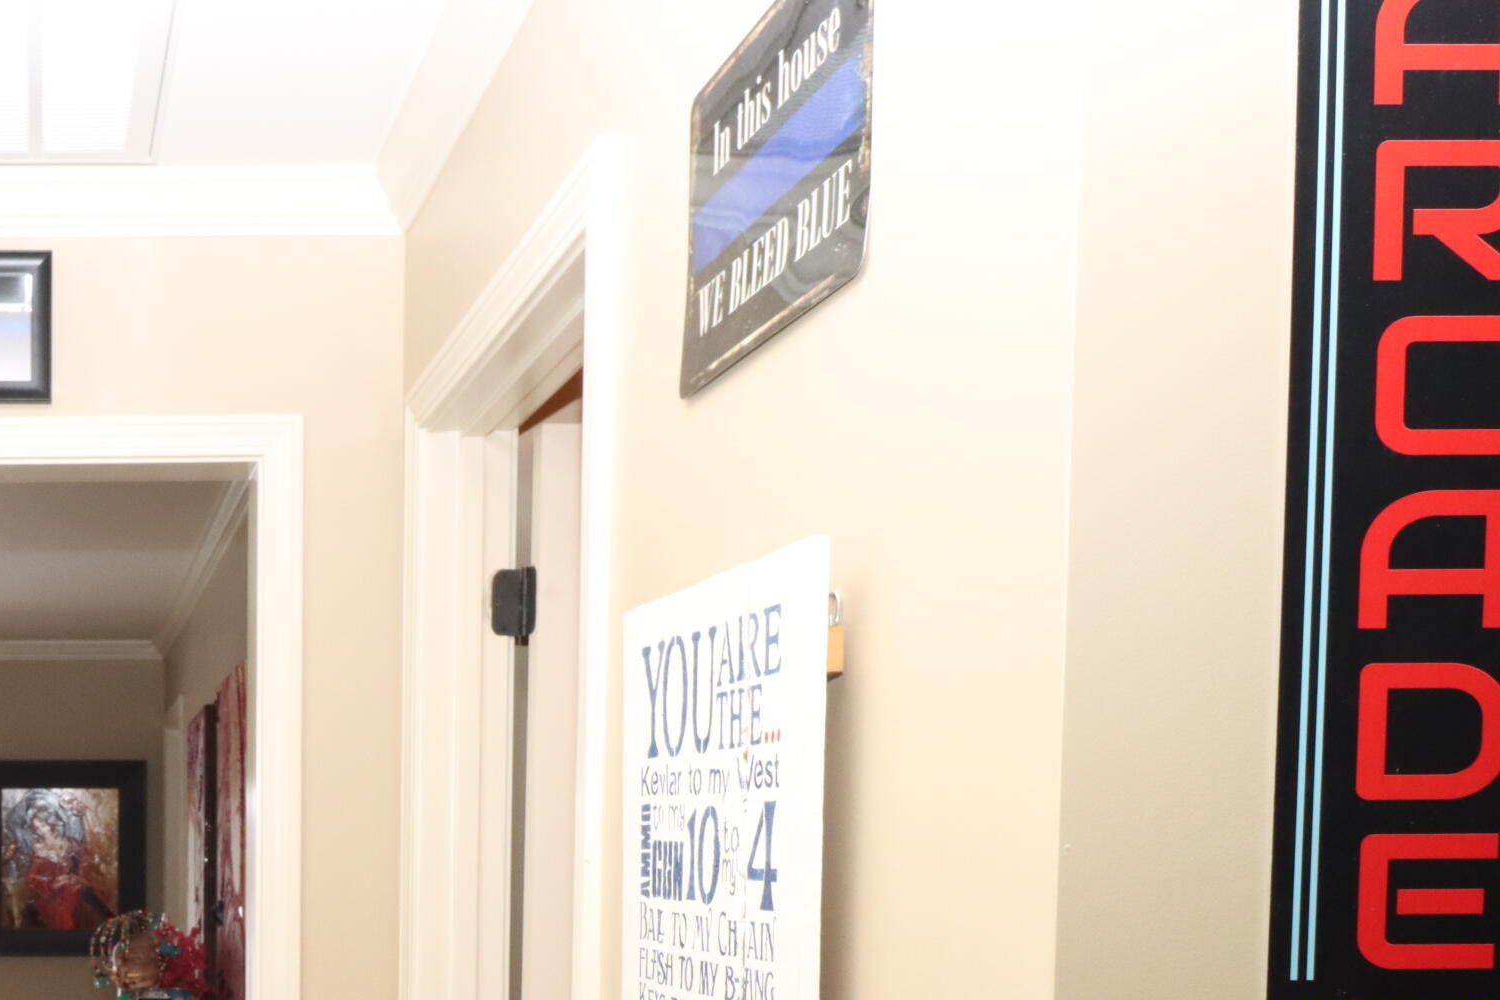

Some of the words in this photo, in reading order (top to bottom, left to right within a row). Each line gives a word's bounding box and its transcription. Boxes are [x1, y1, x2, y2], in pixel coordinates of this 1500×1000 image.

[712, 120, 731, 176] In
[736, 74, 772, 151] this
[776, 6, 841, 110] house
[698, 270, 726, 337] WE
[727, 216, 789, 316] BLEED
[793, 159, 852, 262] BLUE
[642, 625, 717, 759] YOU
[717, 603, 782, 687] ARE
[640, 764, 682, 797] Kevlar
[688, 764, 703, 796] to
[708, 768, 731, 800] my
[686, 804, 721, 906] 10
[747, 800, 778, 912] 4
[671, 911, 688, 950] TO
[692, 908, 713, 953] MY
[678, 956, 695, 992] TO
[698, 961, 719, 998] MY
